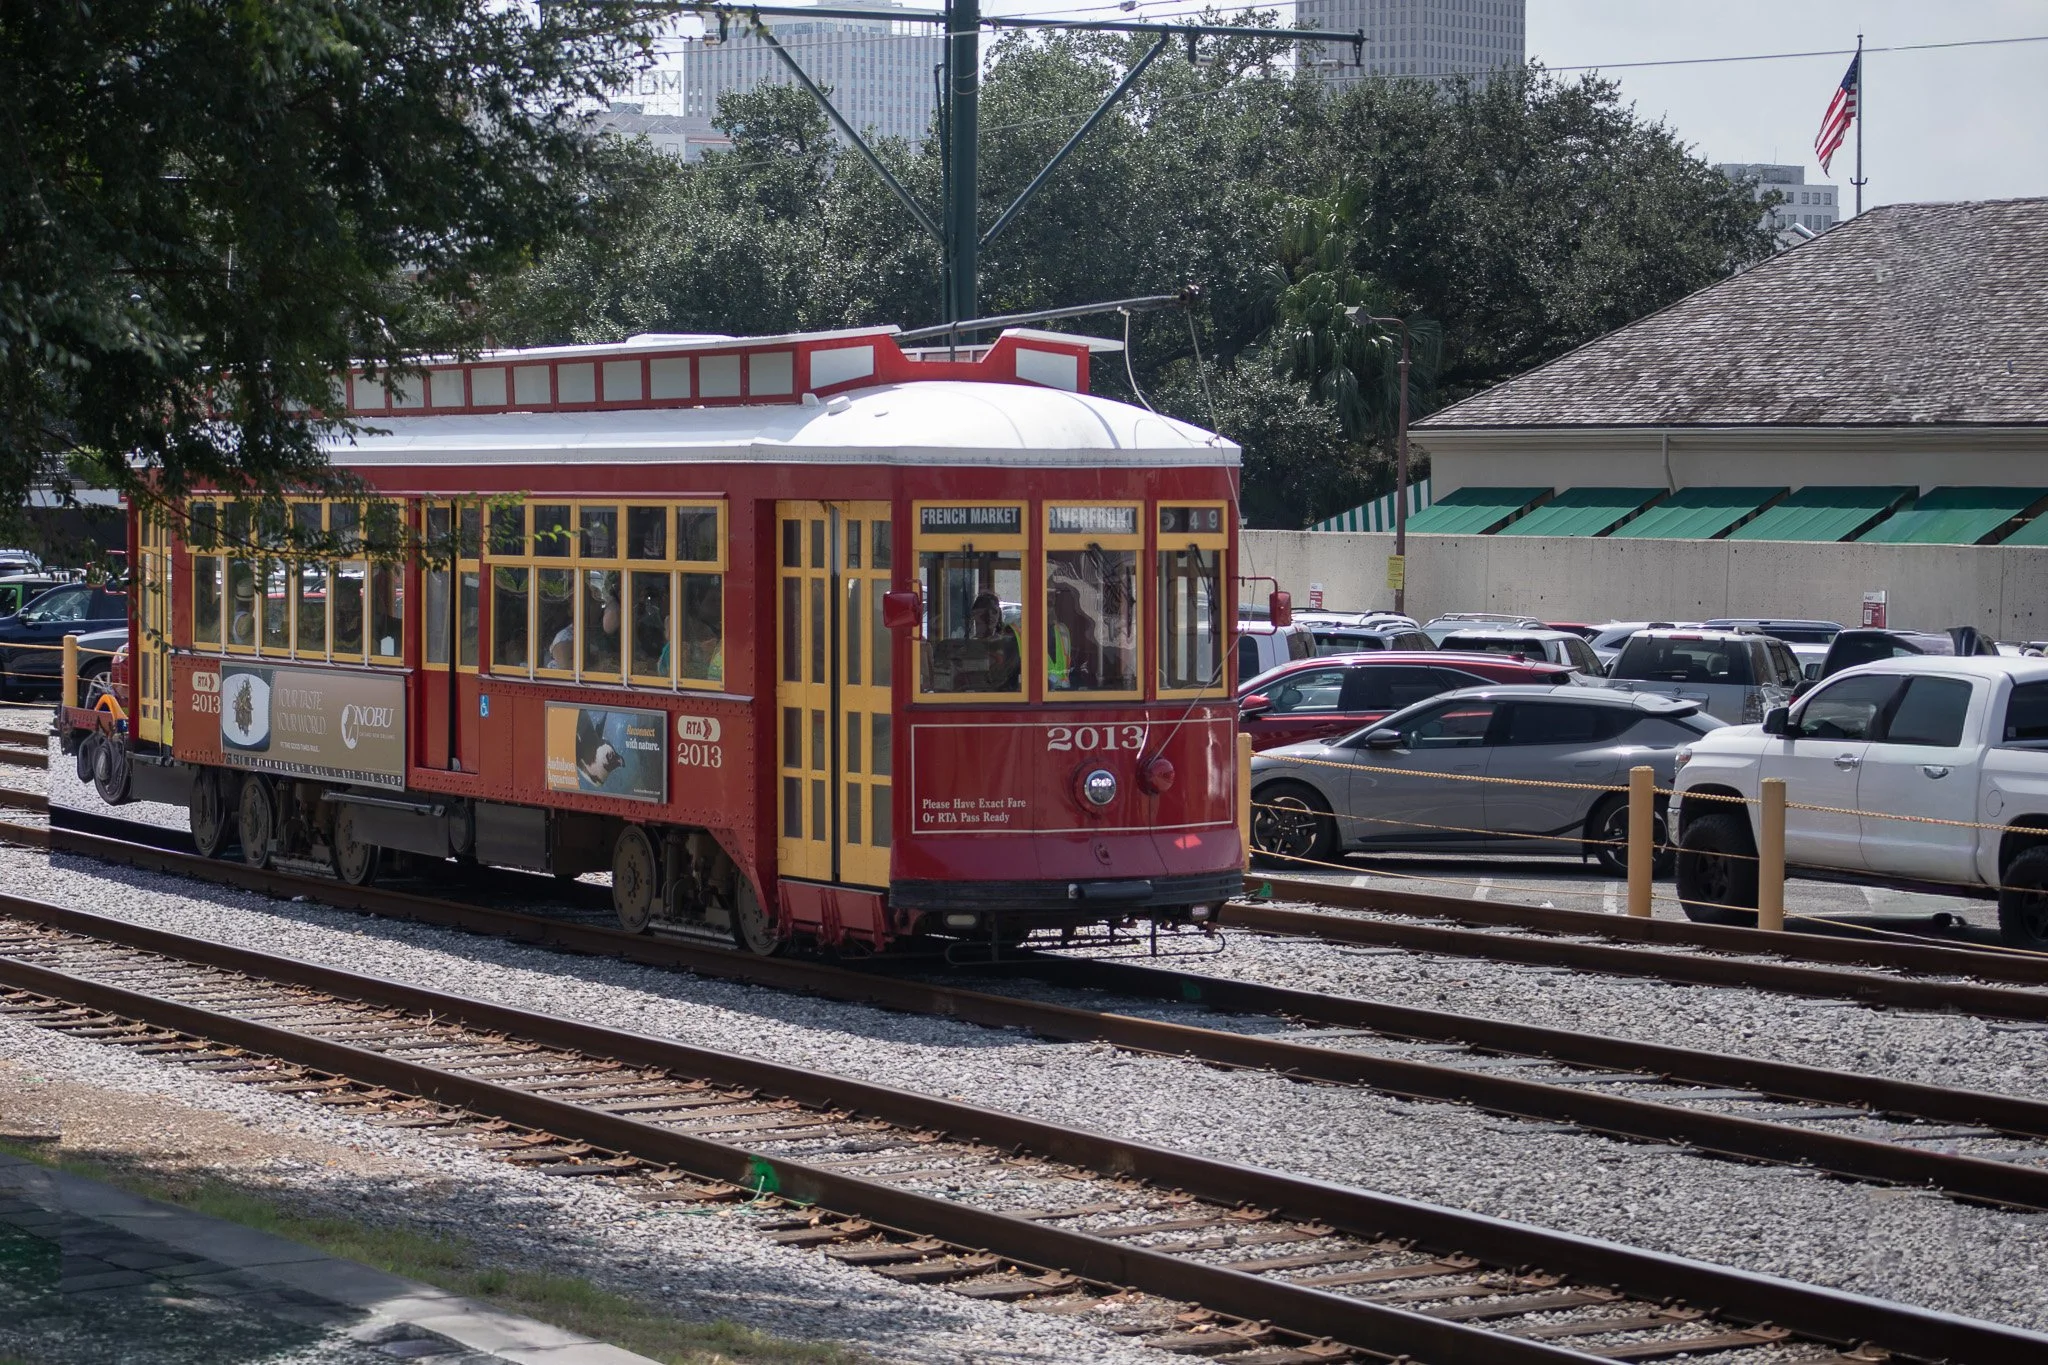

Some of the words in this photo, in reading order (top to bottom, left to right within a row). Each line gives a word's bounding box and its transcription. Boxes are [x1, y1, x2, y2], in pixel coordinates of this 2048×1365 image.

[921, 508, 967, 525] FRENCH
[970, 508, 1018, 525] MARKET
[1049, 507, 1135, 529] RIVERFRONT
[197, 675, 208, 687] RTA
[192, 693, 220, 714] 2013
[352, 705, 394, 728] NOBU
[685, 721, 702, 736] RTA
[626, 738, 638, 749] with
[638, 742, 660, 751] nature.
[1047, 726, 1145, 751] 2013
[677, 743, 722, 769] 2013
[309, 765, 330, 777] CALL
[922, 799, 950, 810] Please
[953, 798, 976, 809] Have
[979, 798, 1004, 809] Exact
[1007, 797, 1027, 808] Fare
[922, 812, 934, 823] Or
[938, 812, 958, 823] RTA
[961, 812, 980, 823] Pass
[983, 811, 1010, 825] Ready
